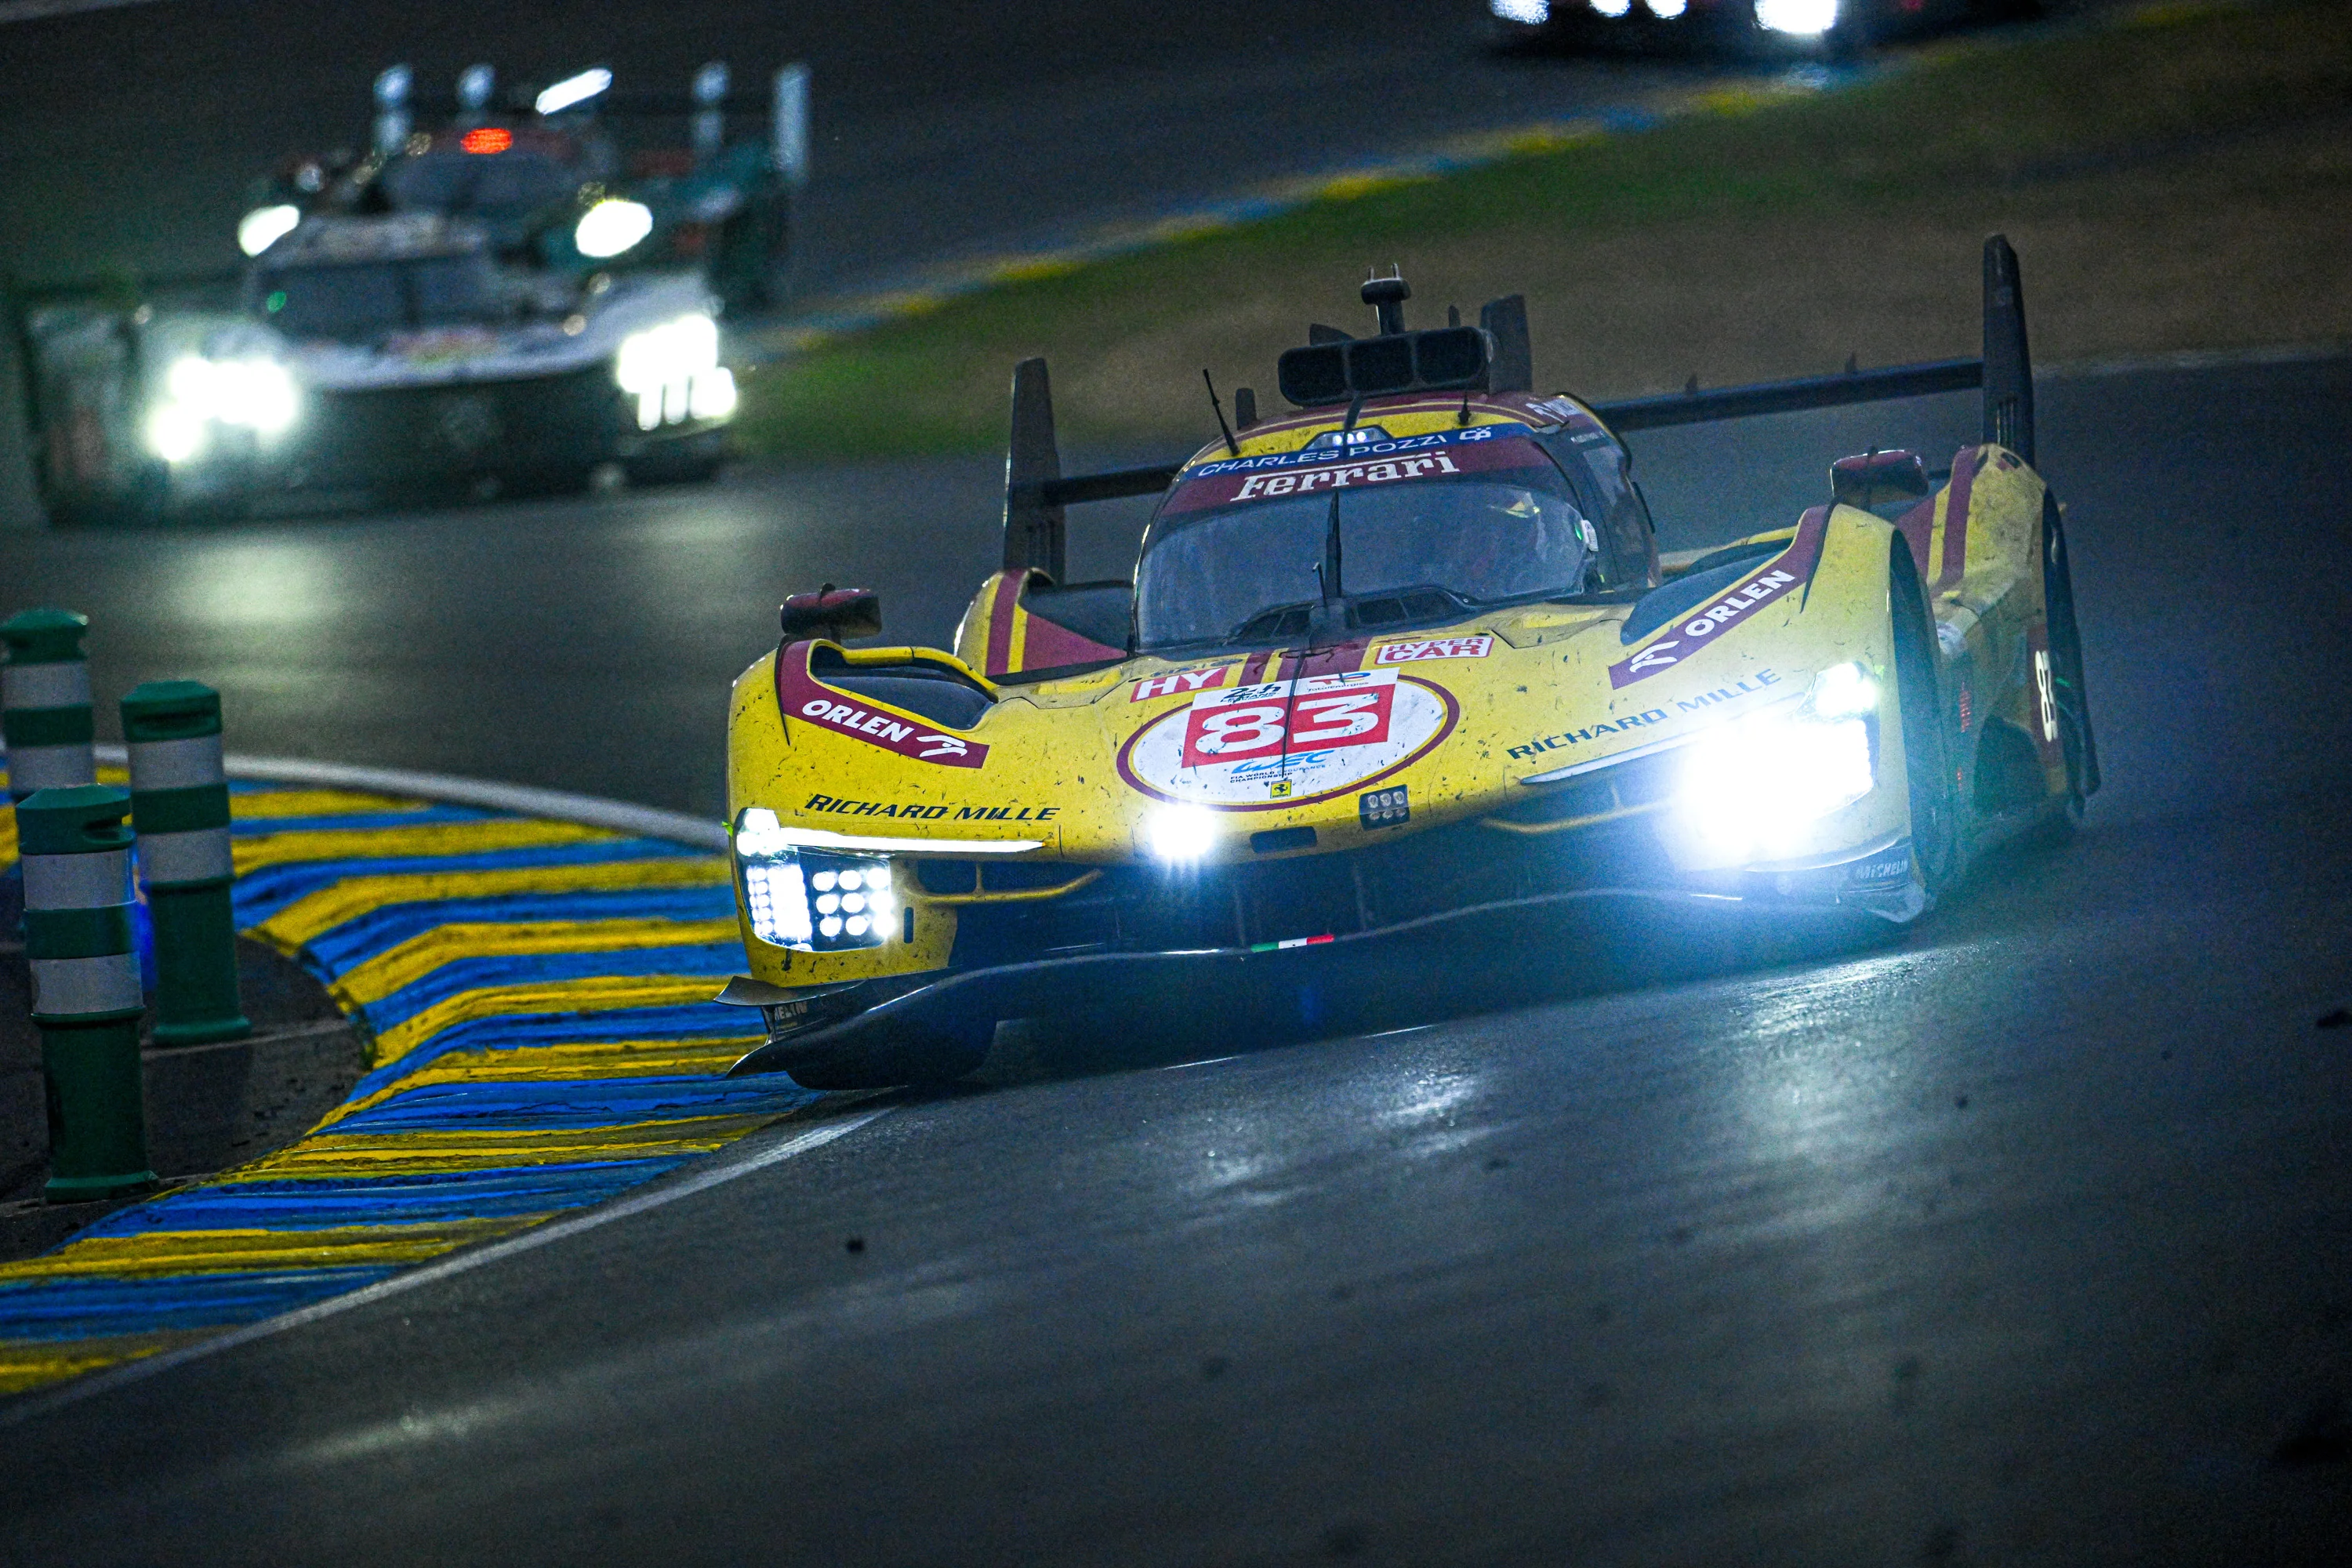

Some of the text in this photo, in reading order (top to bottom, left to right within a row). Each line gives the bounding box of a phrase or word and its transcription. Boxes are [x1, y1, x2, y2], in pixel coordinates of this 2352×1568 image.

[1198, 450, 1339, 476] CHARLES
[1350, 434, 1447, 456] POZZI
[1230, 451, 1460, 502] Ferrari
[1685, 569, 1795, 637] ORLEN
[1385, 644, 1481, 661] CAR
[1388, 638, 1484, 652] HYPER
[1136, 667, 1222, 700] HY
[802, 699, 914, 743] ORLEN
[1195, 693, 1378, 753] 83
[1506, 669, 1781, 760] RICHARD MILLE
[1230, 771, 1293, 783] CHAMPIONSHIP
[804, 793, 1061, 821] RICHARD MILLE
